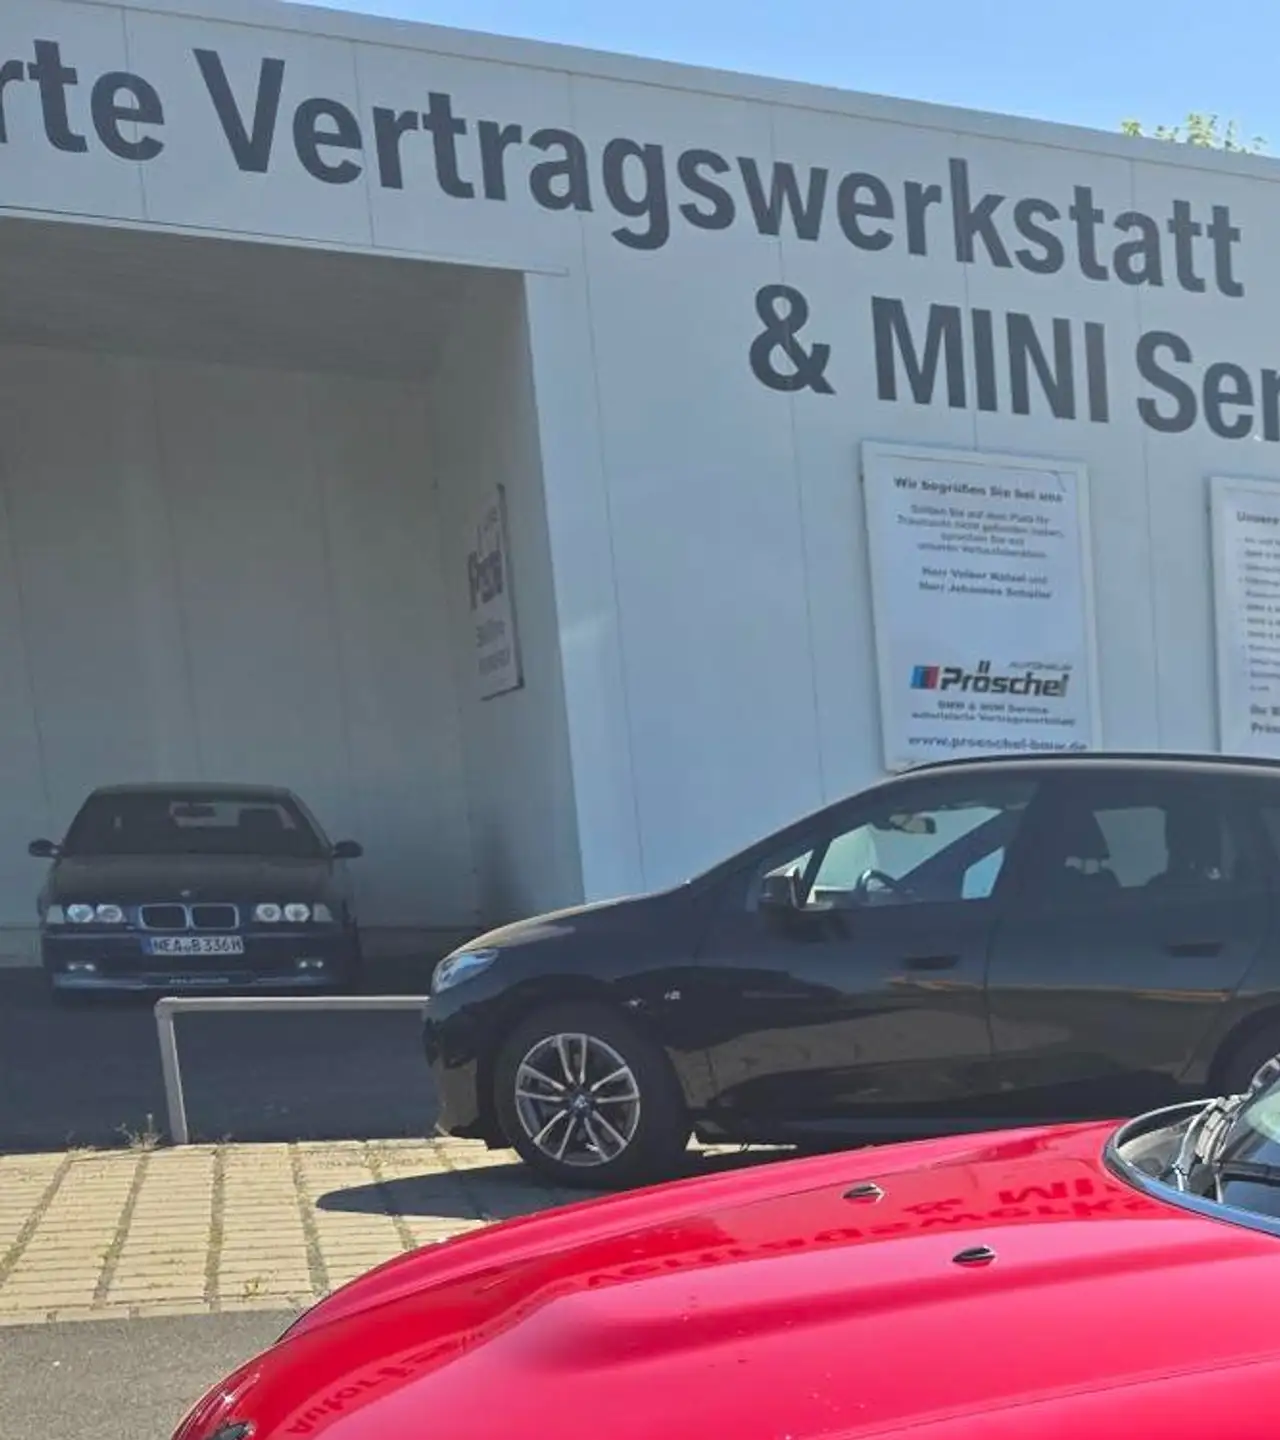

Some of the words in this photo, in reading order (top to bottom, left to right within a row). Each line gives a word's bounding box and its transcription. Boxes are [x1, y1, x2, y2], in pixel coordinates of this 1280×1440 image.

[192, 48, 1246, 297] Vertragswerkstatt
[749, 284, 836, 395] &
[871, 295, 1110, 424] MINI
[940, 660, 1070, 698] Pröschel
